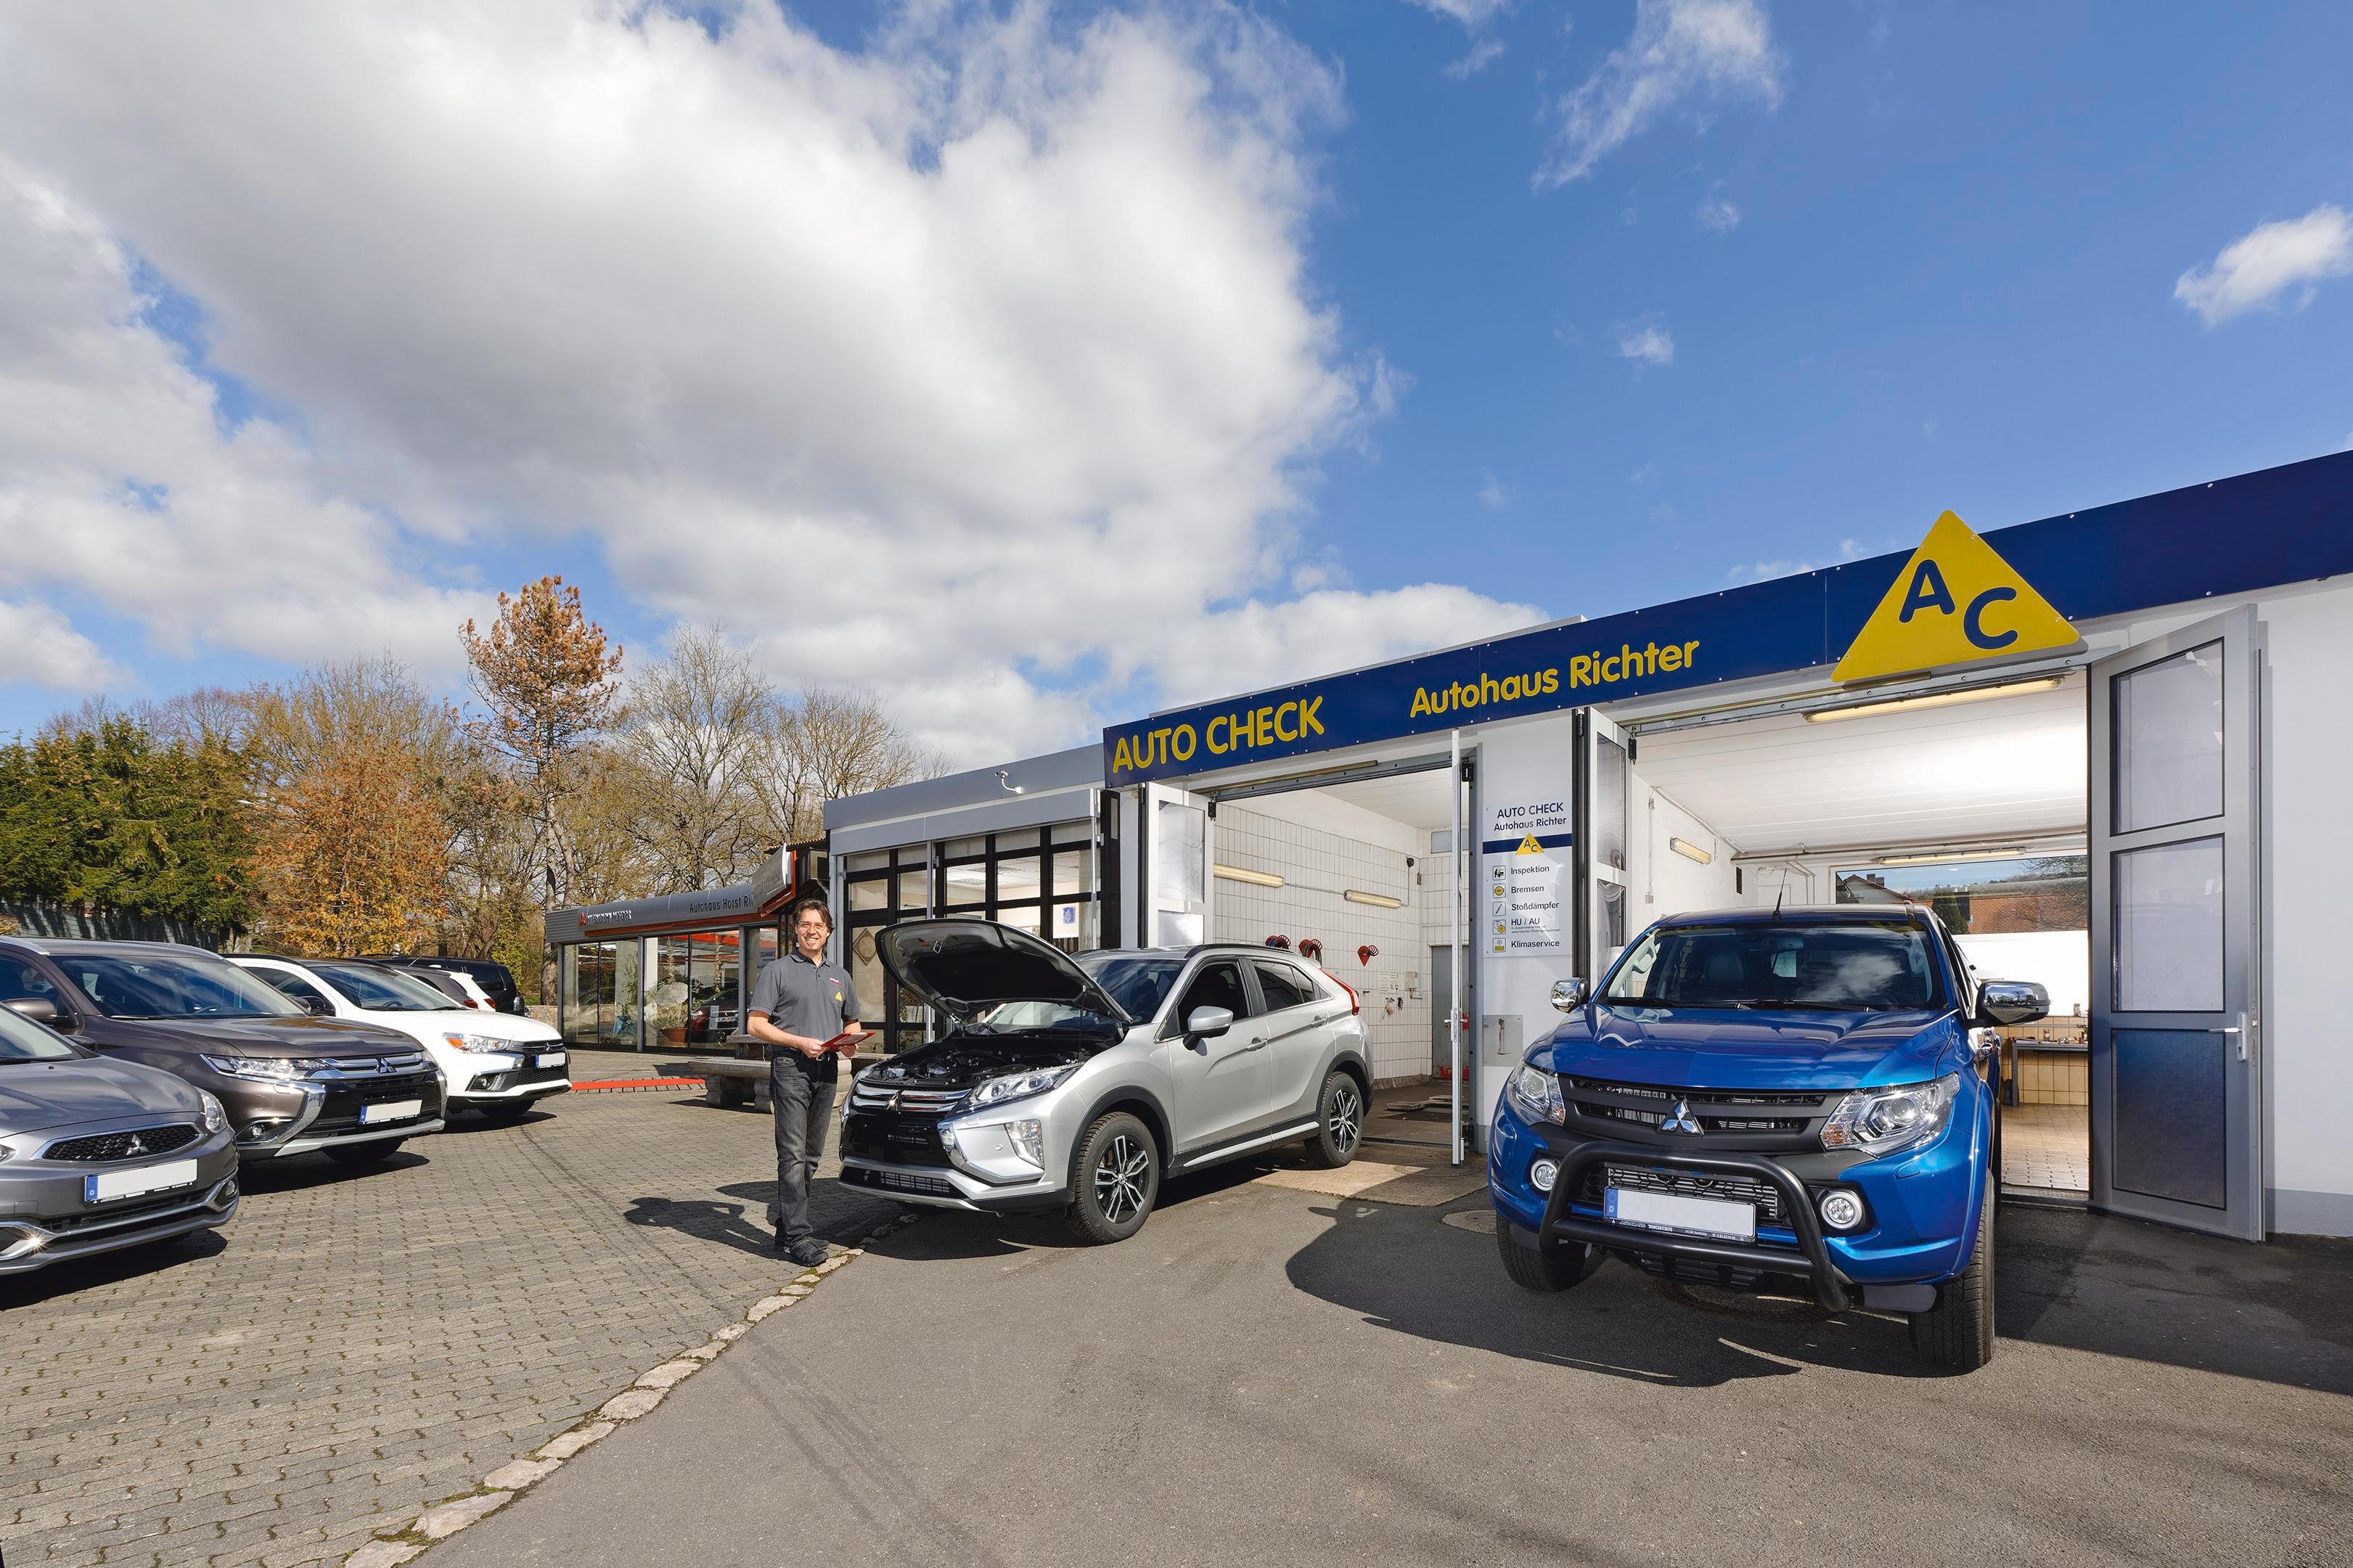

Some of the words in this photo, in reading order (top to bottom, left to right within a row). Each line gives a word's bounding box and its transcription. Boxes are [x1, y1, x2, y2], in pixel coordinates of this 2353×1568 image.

[1409, 668, 1560, 718] Autohaus
[1570, 640, 1700, 689] Richter
[1112, 723, 1197, 774] AUTO
[1206, 695, 1325, 755] CHECK
[1497, 806, 1526, 819] AUTO
[1529, 802, 1564, 815] CHECK
[1494, 821, 1534, 832] Autohaus
[1536, 817, 1567, 827] Richter
[1510, 865, 1550, 876] Inspektion
[1510, 885, 1544, 894] Bremsen
[689, 901, 721, 914] Autohaus
[722, 898, 741, 909] Horst
[1510, 900, 1560, 911] Stoßdämpfer
[1510, 939, 1560, 948] Klimaservice
